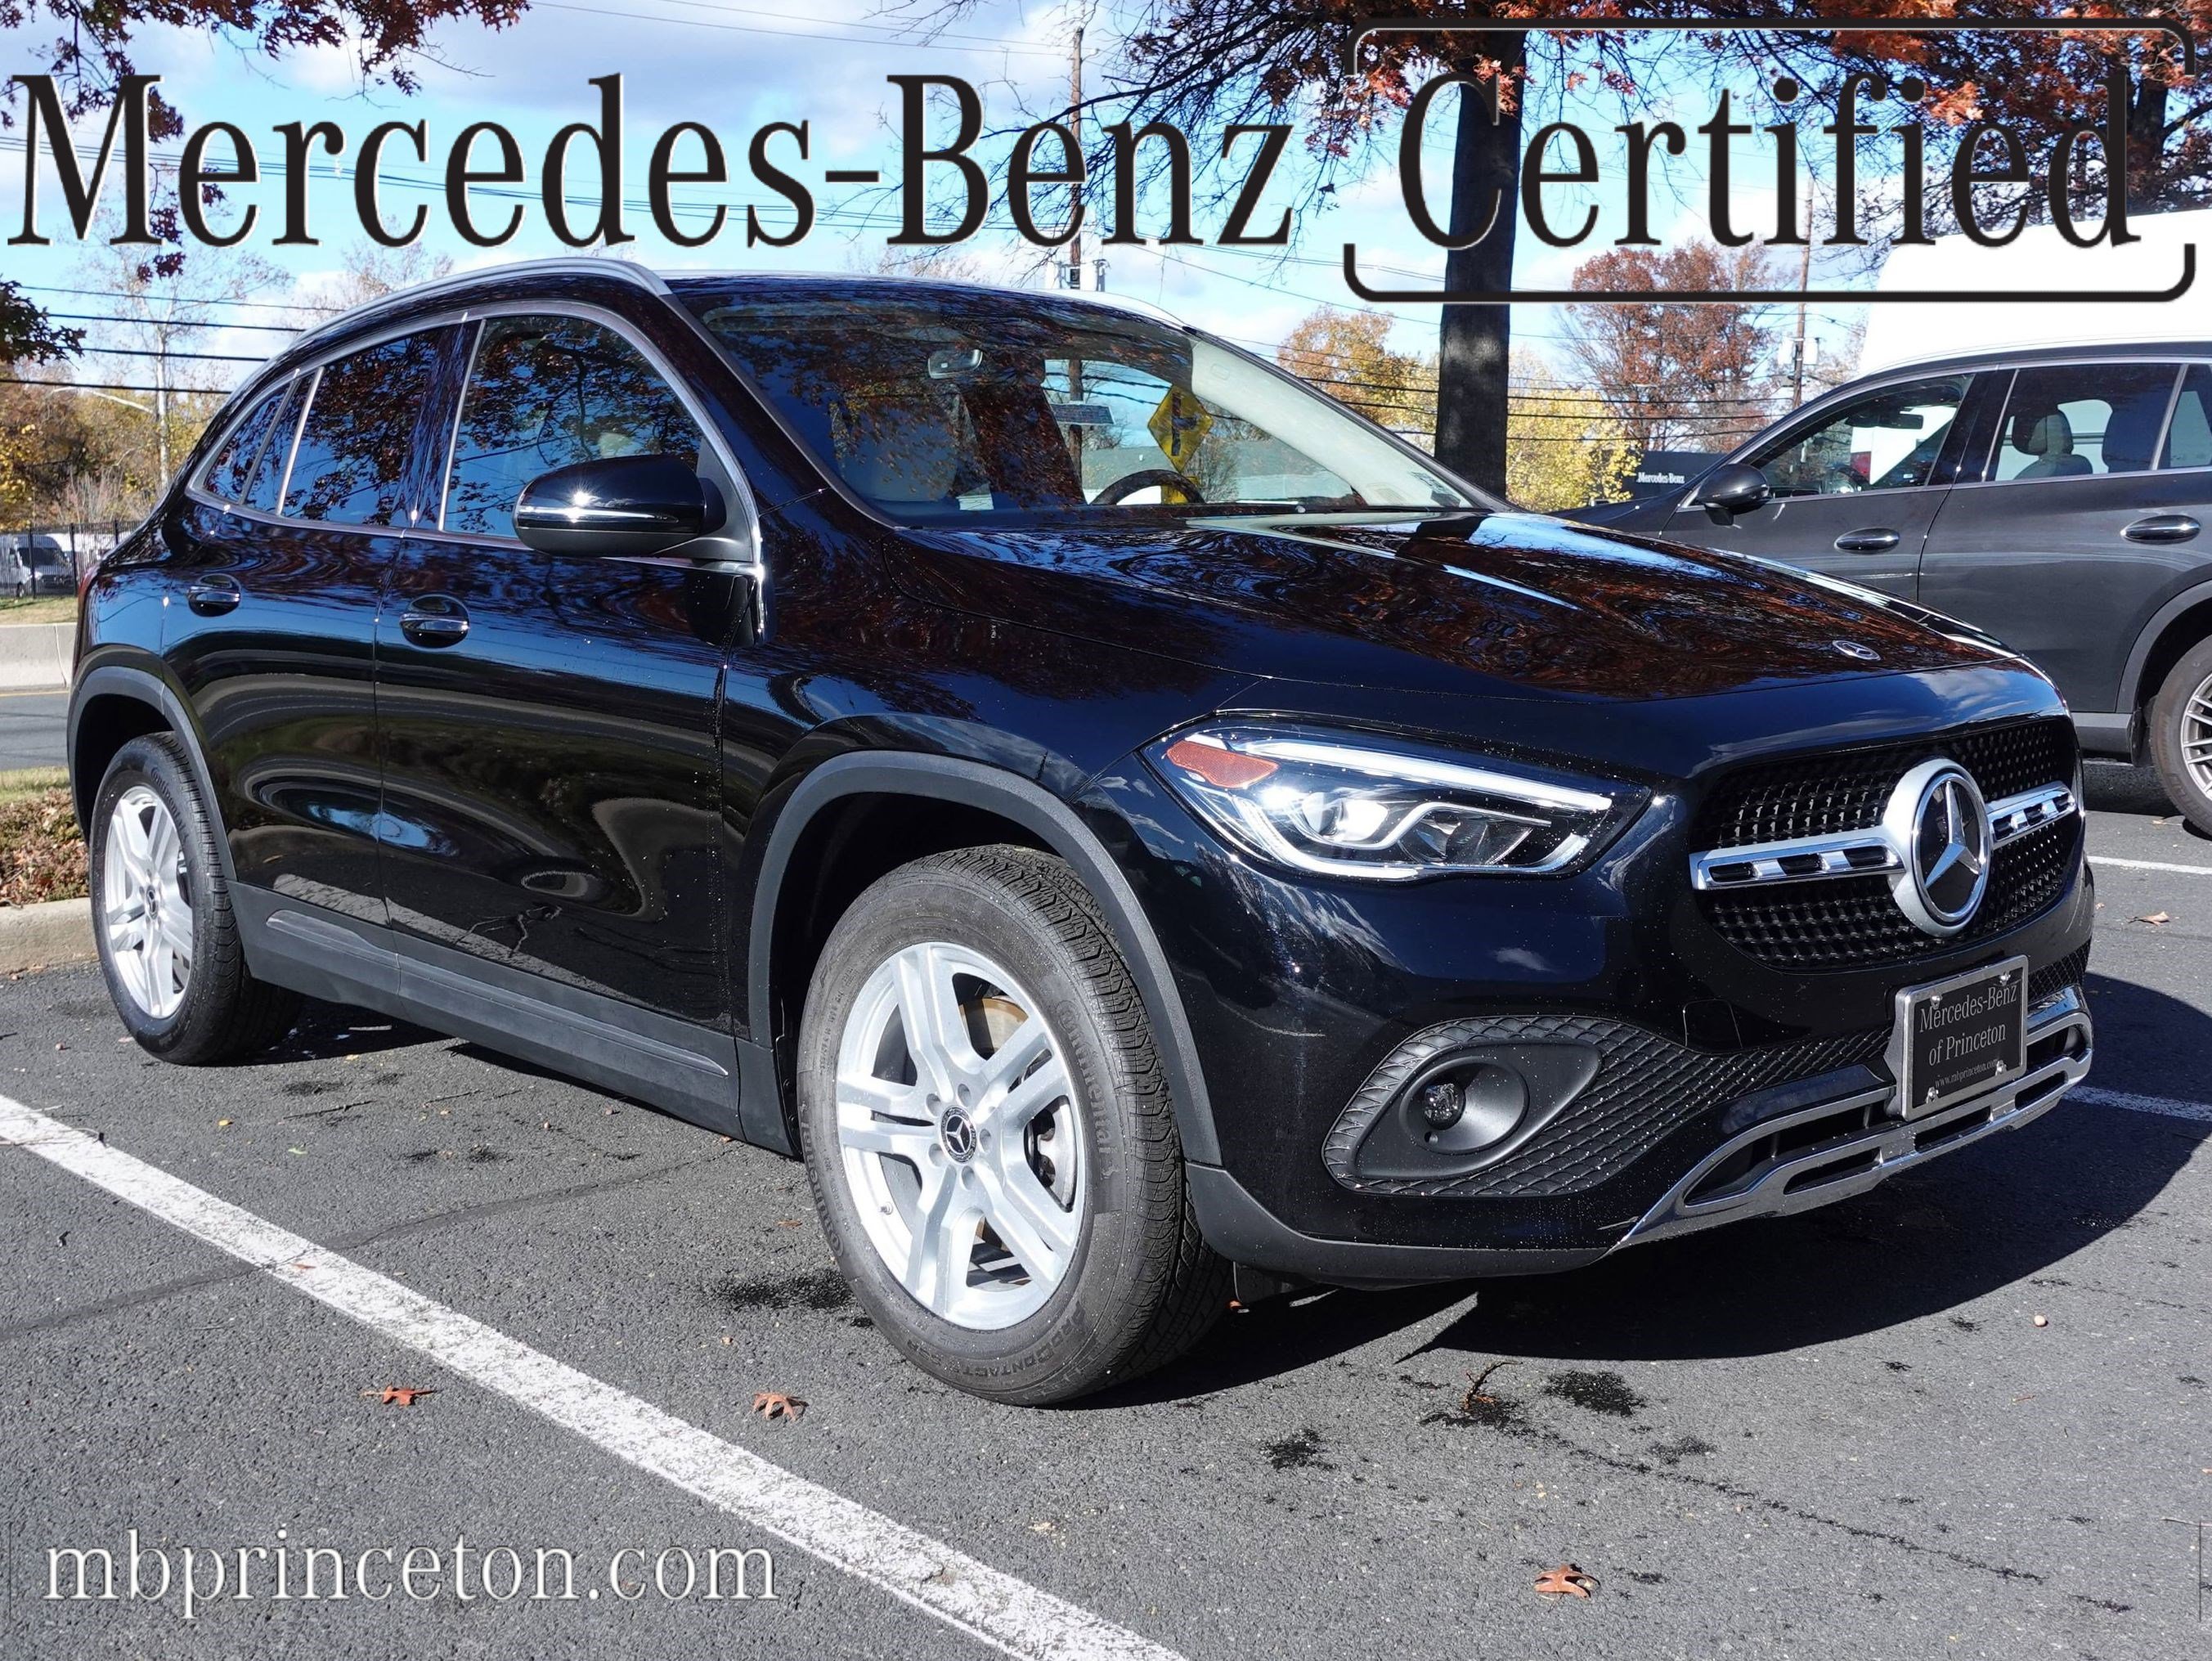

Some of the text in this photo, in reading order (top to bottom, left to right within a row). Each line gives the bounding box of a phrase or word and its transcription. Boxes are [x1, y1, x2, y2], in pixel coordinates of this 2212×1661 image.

[1636, 471, 1685, 484] Mercedes-Benz
[1918, 984, 2017, 1034] Mercedes-Benz
[1929, 1023, 2006, 1066] of Princeton
